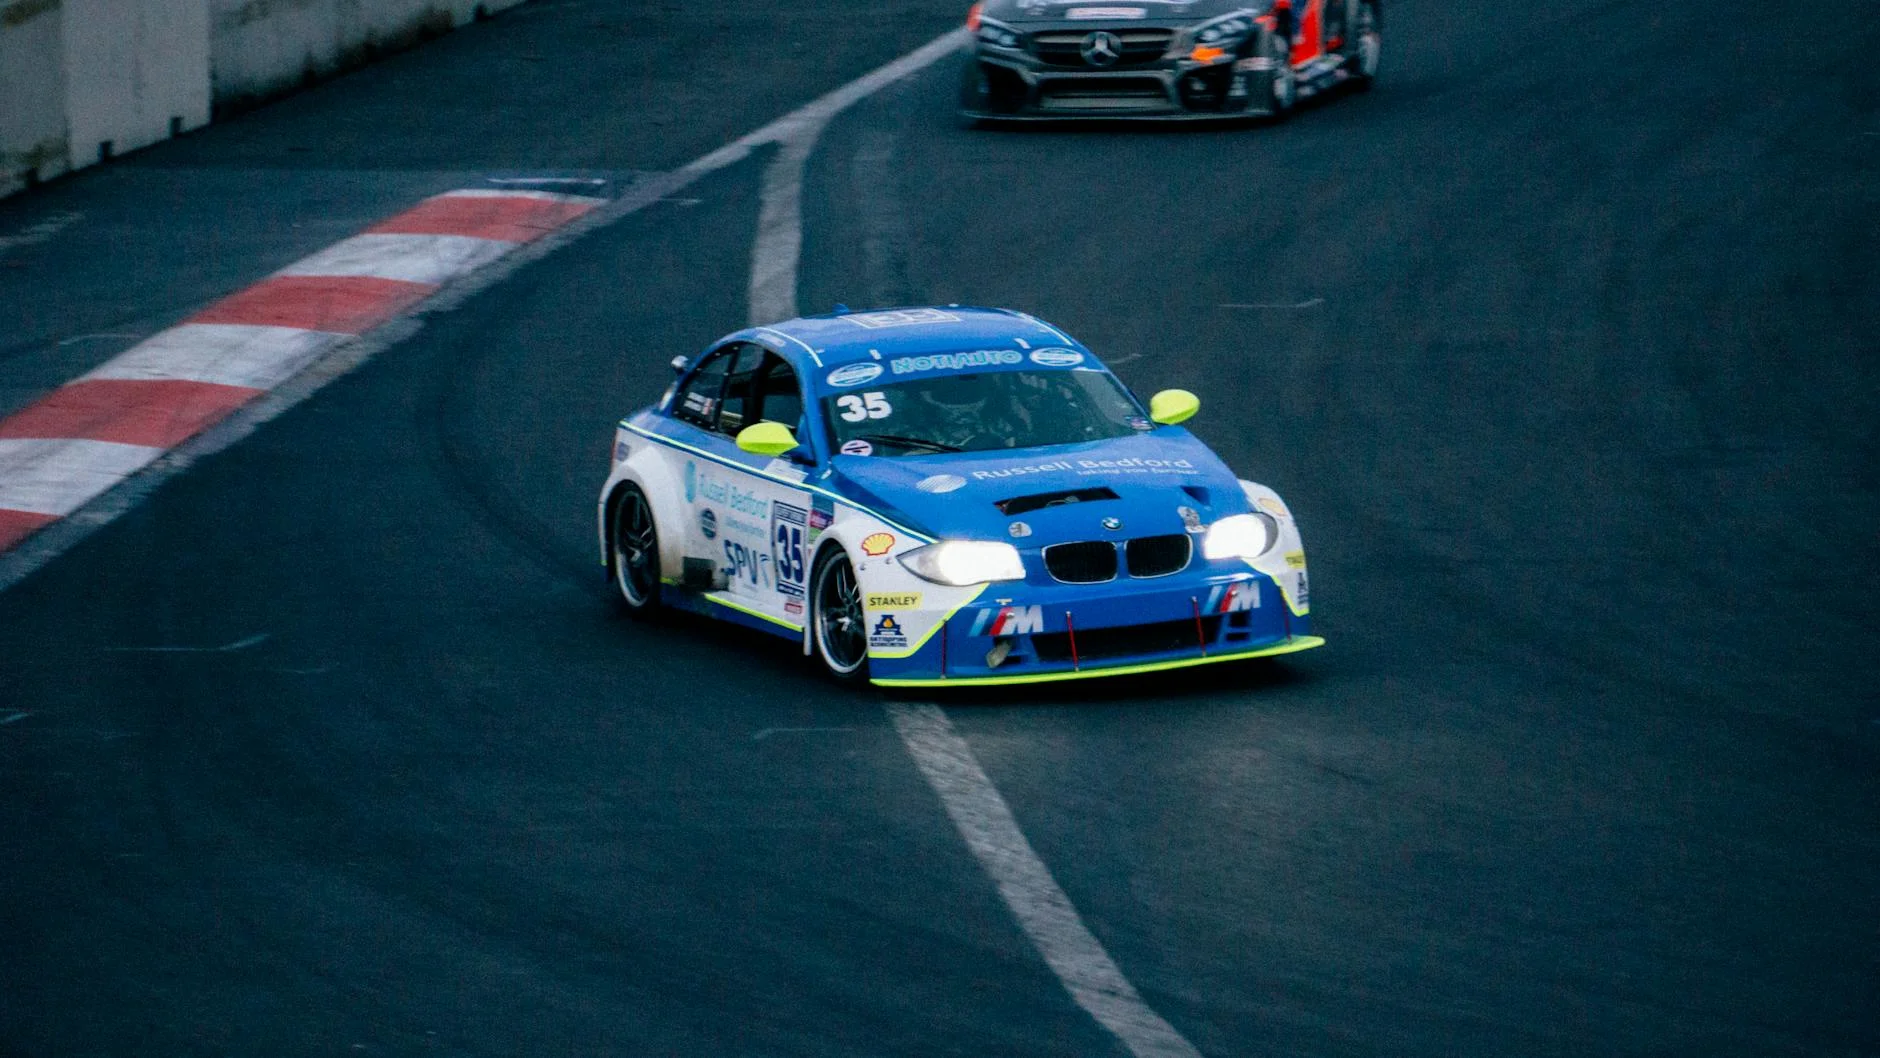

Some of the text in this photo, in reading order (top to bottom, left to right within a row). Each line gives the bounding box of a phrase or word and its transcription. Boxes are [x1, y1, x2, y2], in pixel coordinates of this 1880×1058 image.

[837, 392, 892, 422] 35
[972, 458, 1194, 480] Russell Bedford
[777, 524, 805, 584] 35
[869, 596, 918, 606] STANLEY
